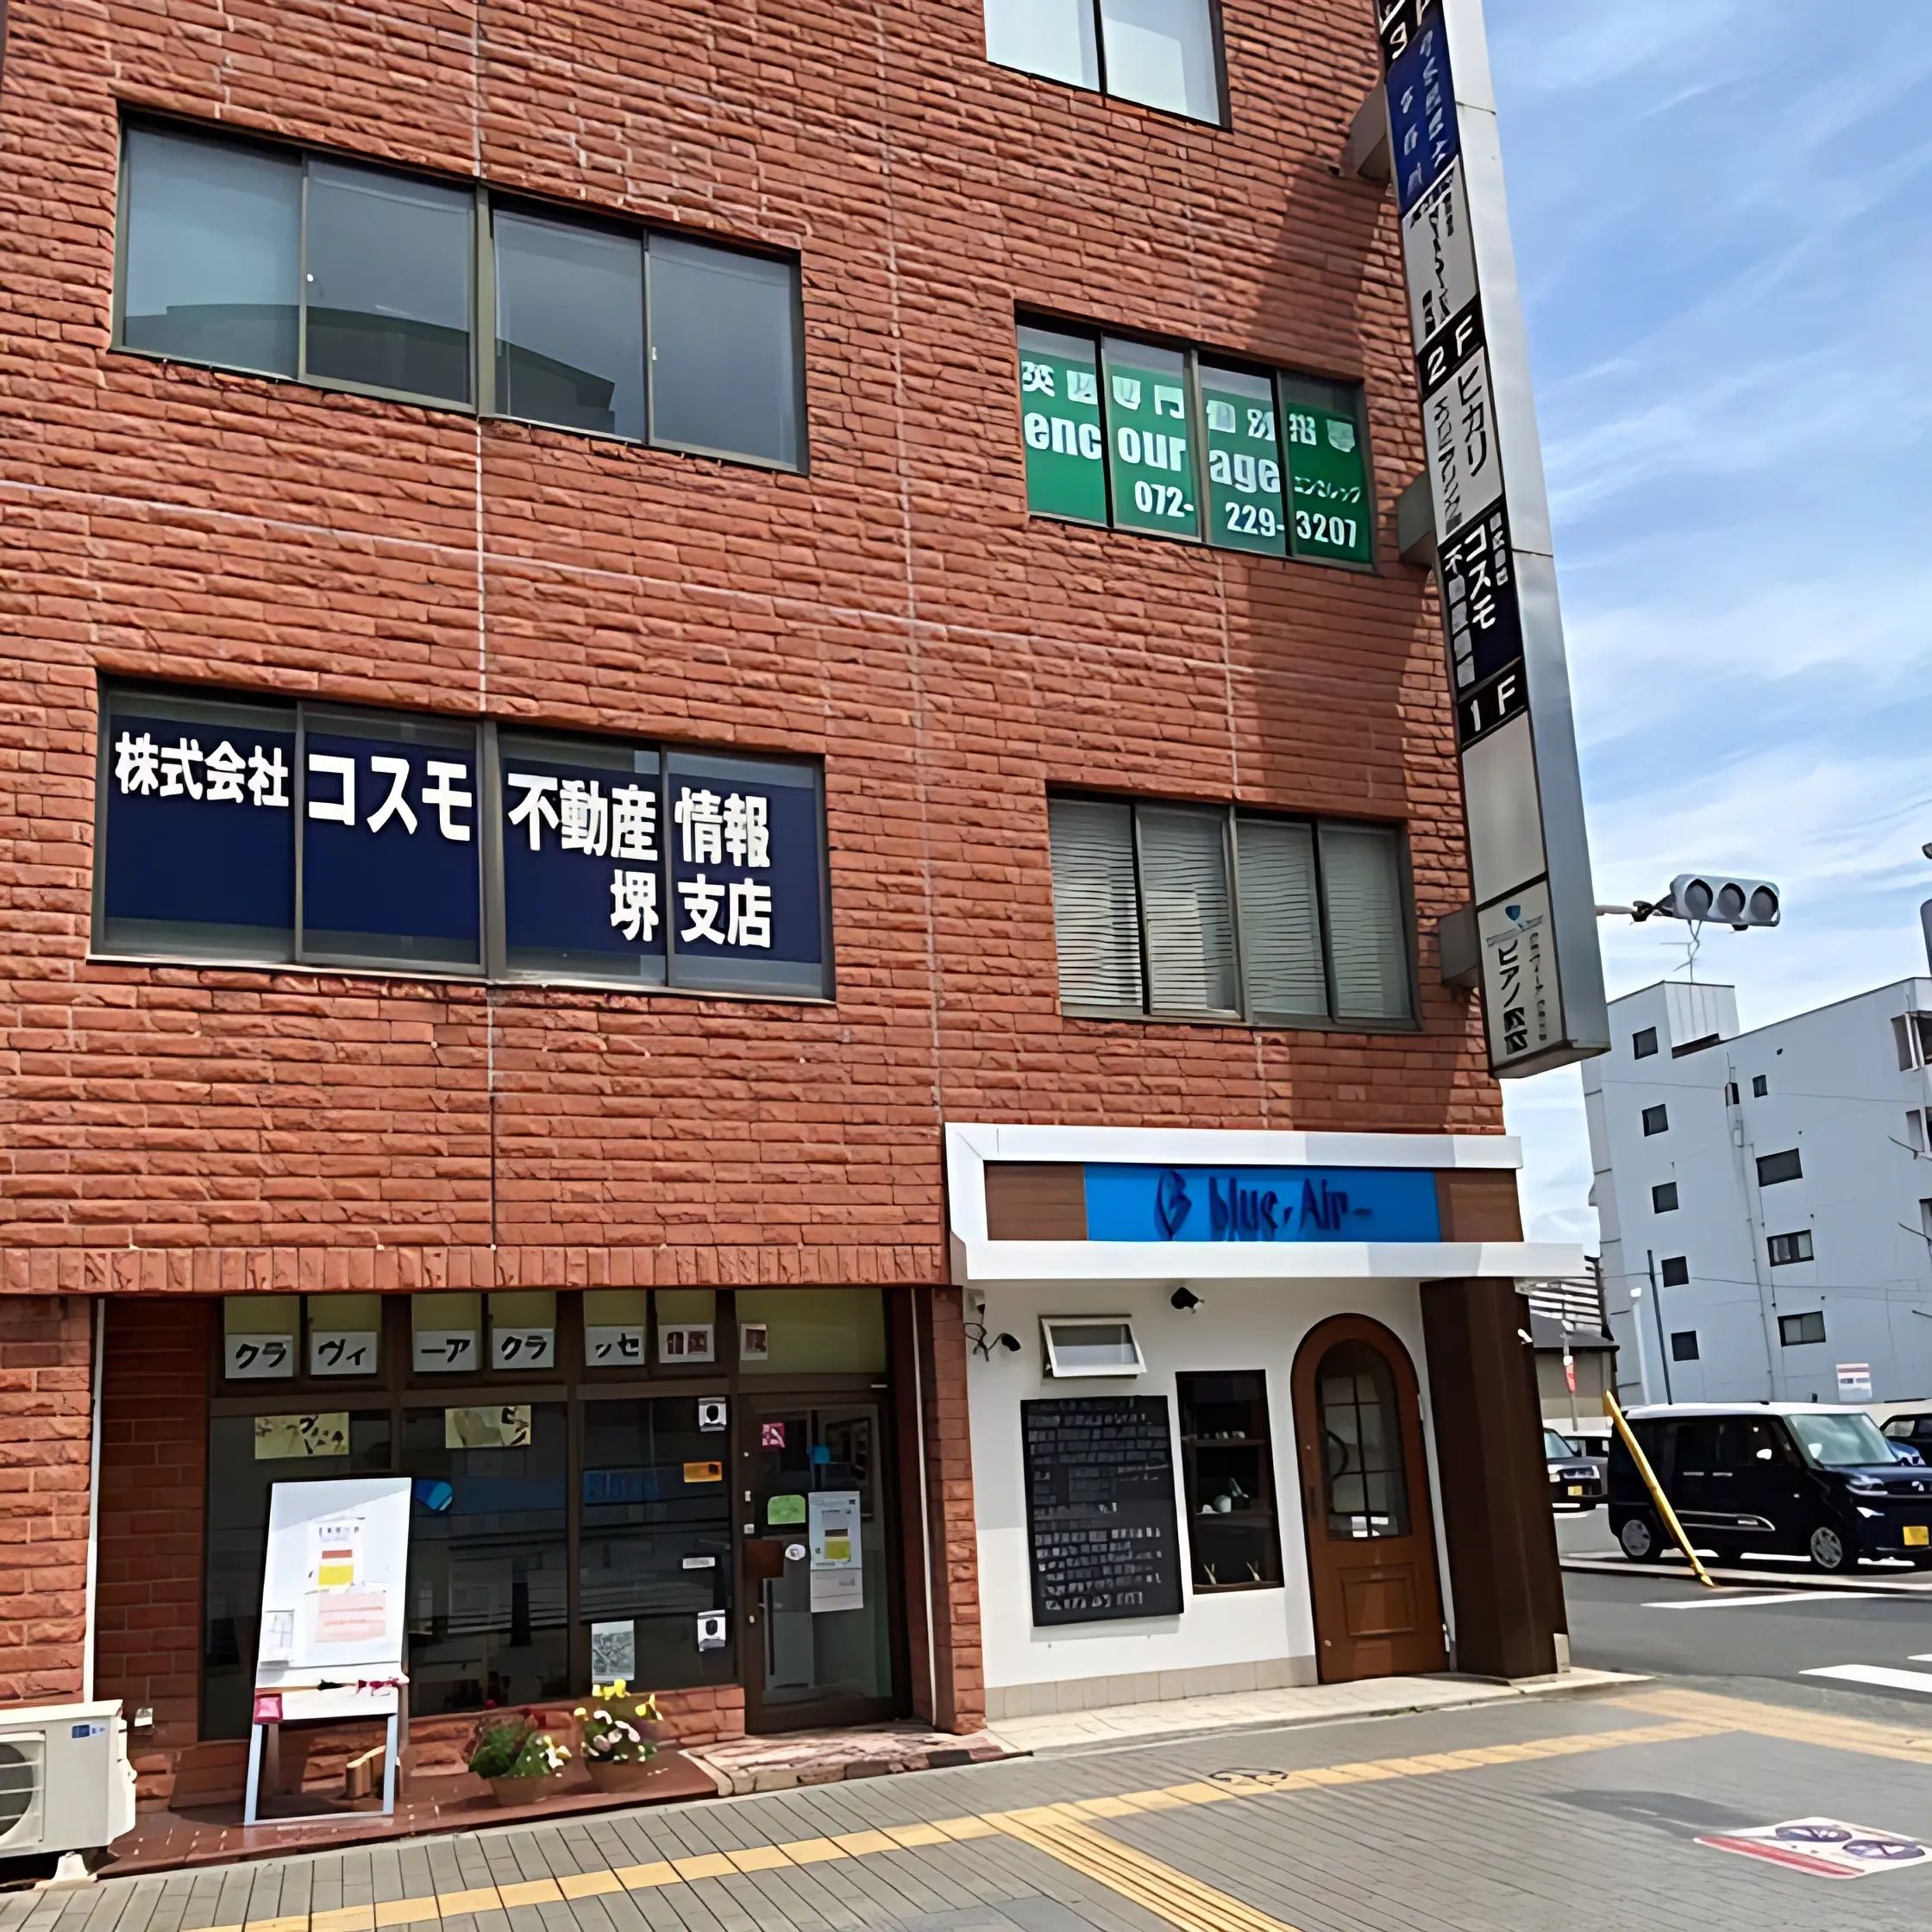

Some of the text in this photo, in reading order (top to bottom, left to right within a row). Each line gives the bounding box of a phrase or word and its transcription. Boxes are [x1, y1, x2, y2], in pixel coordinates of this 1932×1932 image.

[1428, 315, 1472, 386] 2F
[1458, 365, 1487, 476] ヒカリ
[1464, 524, 1496, 630] コスモ
